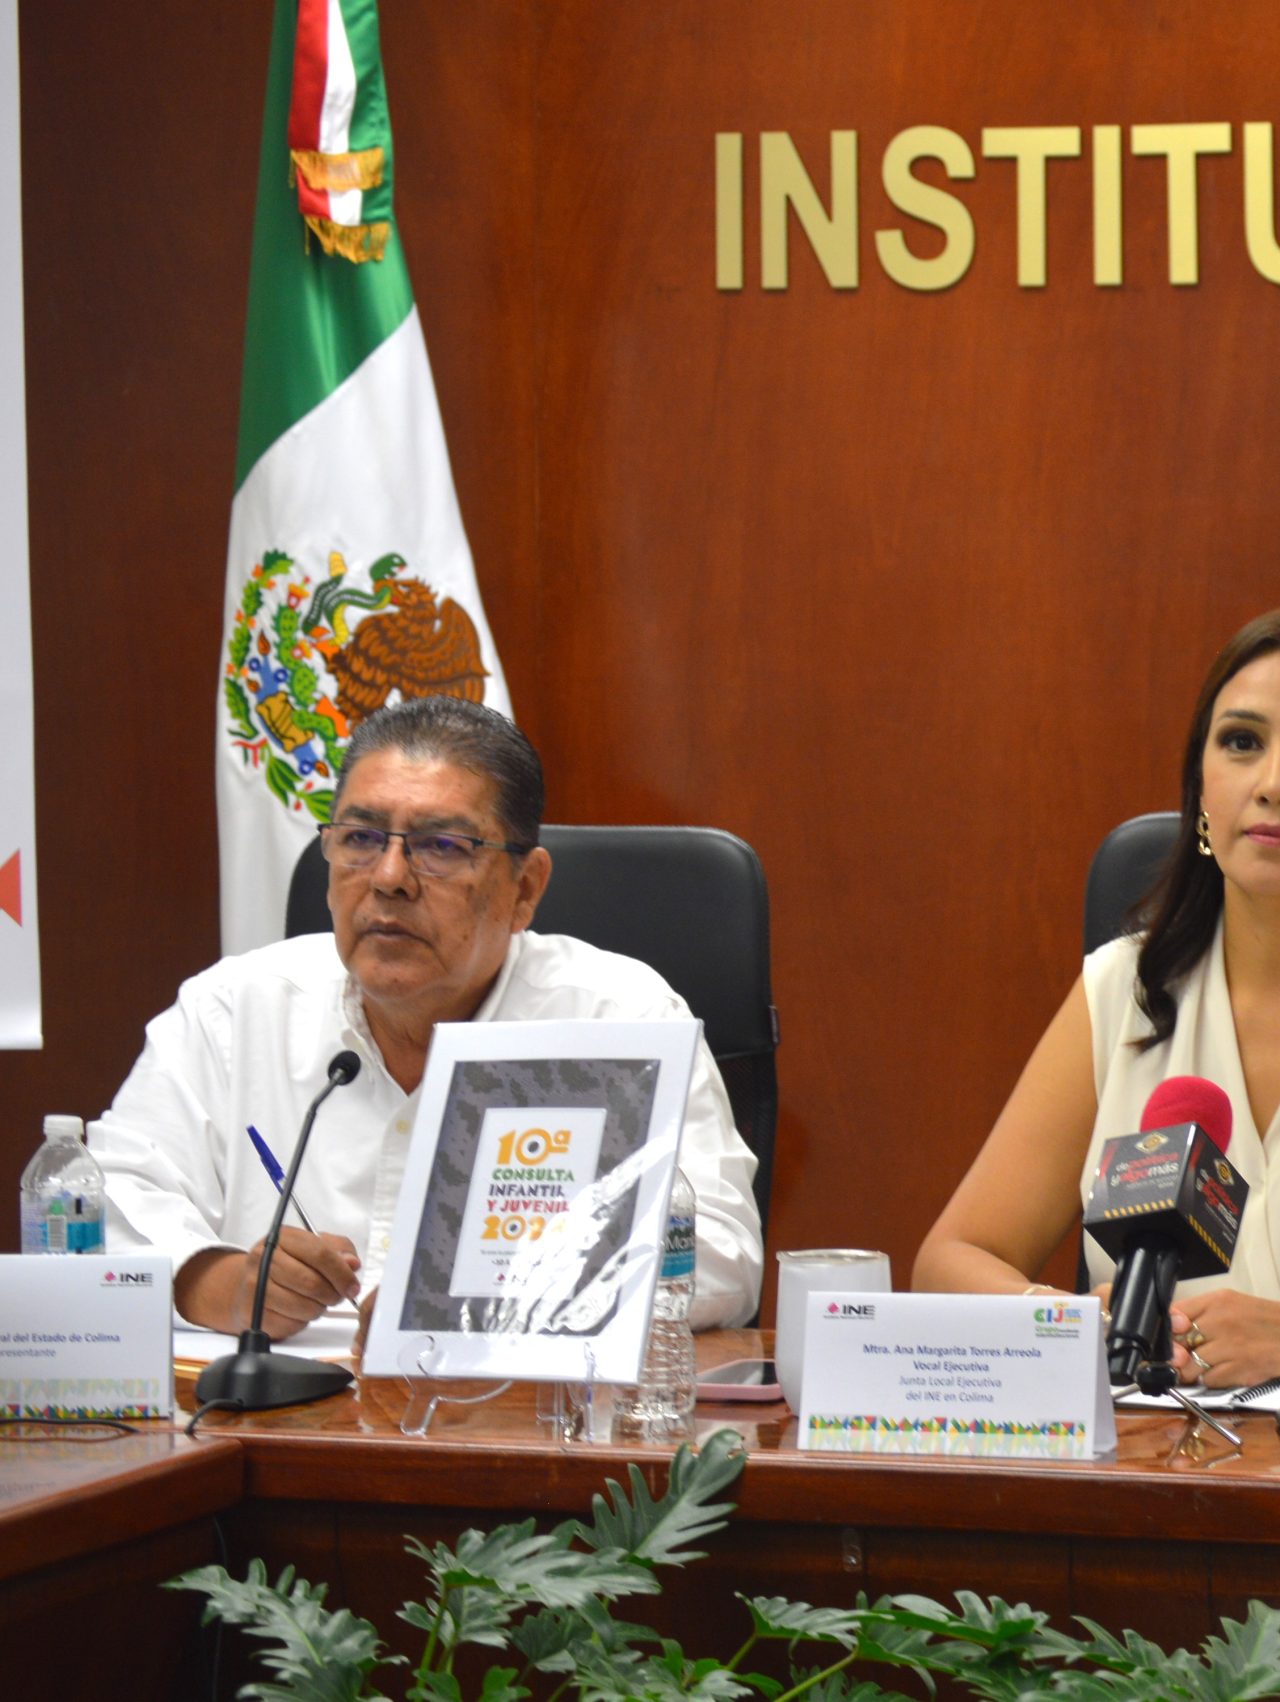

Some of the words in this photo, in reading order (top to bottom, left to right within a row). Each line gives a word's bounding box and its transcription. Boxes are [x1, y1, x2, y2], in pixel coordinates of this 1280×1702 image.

[492, 1168, 575, 1182] CONSULTA
[489, 1184, 565, 1197] INFANTIL
[487, 1200, 497, 1212] Y
[500, 1200, 570, 1213] JUVENIL
[480, 1215, 566, 1242] 202
[120, 1272, 153, 1283] INE
[843, 1304, 876, 1315] INE
[13, 1333, 29, 1342] del
[32, 1333, 67, 1342] Estado
[69, 1333, 82, 1342] de
[84, 1333, 120, 1342] Colima
[863, 1344, 890, 1354] Mtra.
[894, 1345, 914, 1355] Ana
[917, 1345, 967, 1358] Margarita
[969, 1346, 1000, 1357] Torres
[1003, 1347, 1041, 1358] Arreola
[913, 1361, 941, 1371] Vocal
[943, 1361, 990, 1373] Ejecutiva
[899, 1376, 926, 1386] Junta
[928, 1376, 953, 1386] Local
[956, 1377, 1002, 1389] Ejecutiva
[906, 1391, 921, 1401] del
[924, 1392, 941, 1402] INE
[944, 1394, 956, 1402] en
[959, 1392, 994, 1403] Colima
